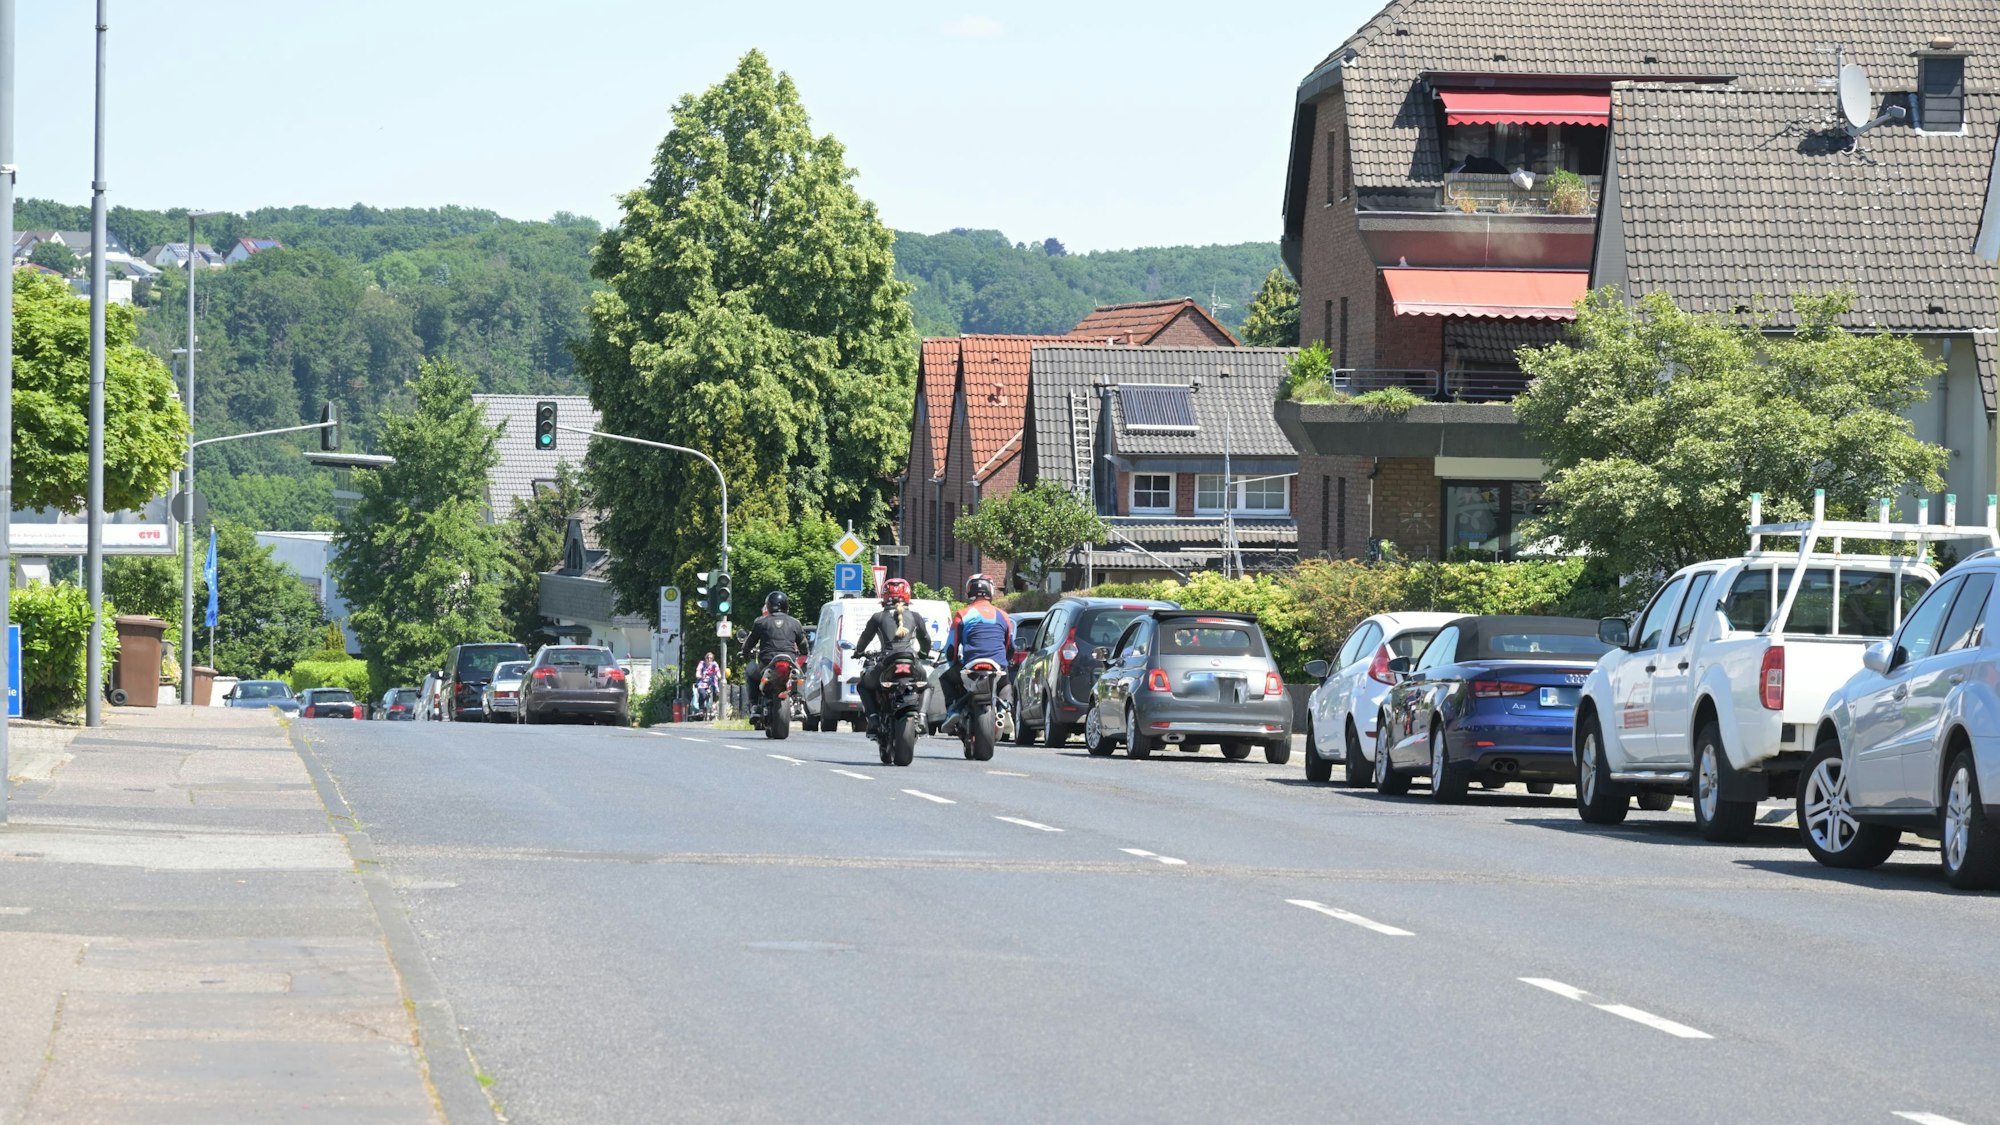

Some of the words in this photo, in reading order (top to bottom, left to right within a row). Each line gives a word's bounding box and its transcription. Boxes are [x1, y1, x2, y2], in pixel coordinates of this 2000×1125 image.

[138, 530, 161, 539] GTÜ
[842, 567, 856, 588] P
[1512, 702, 1526, 710] A3
